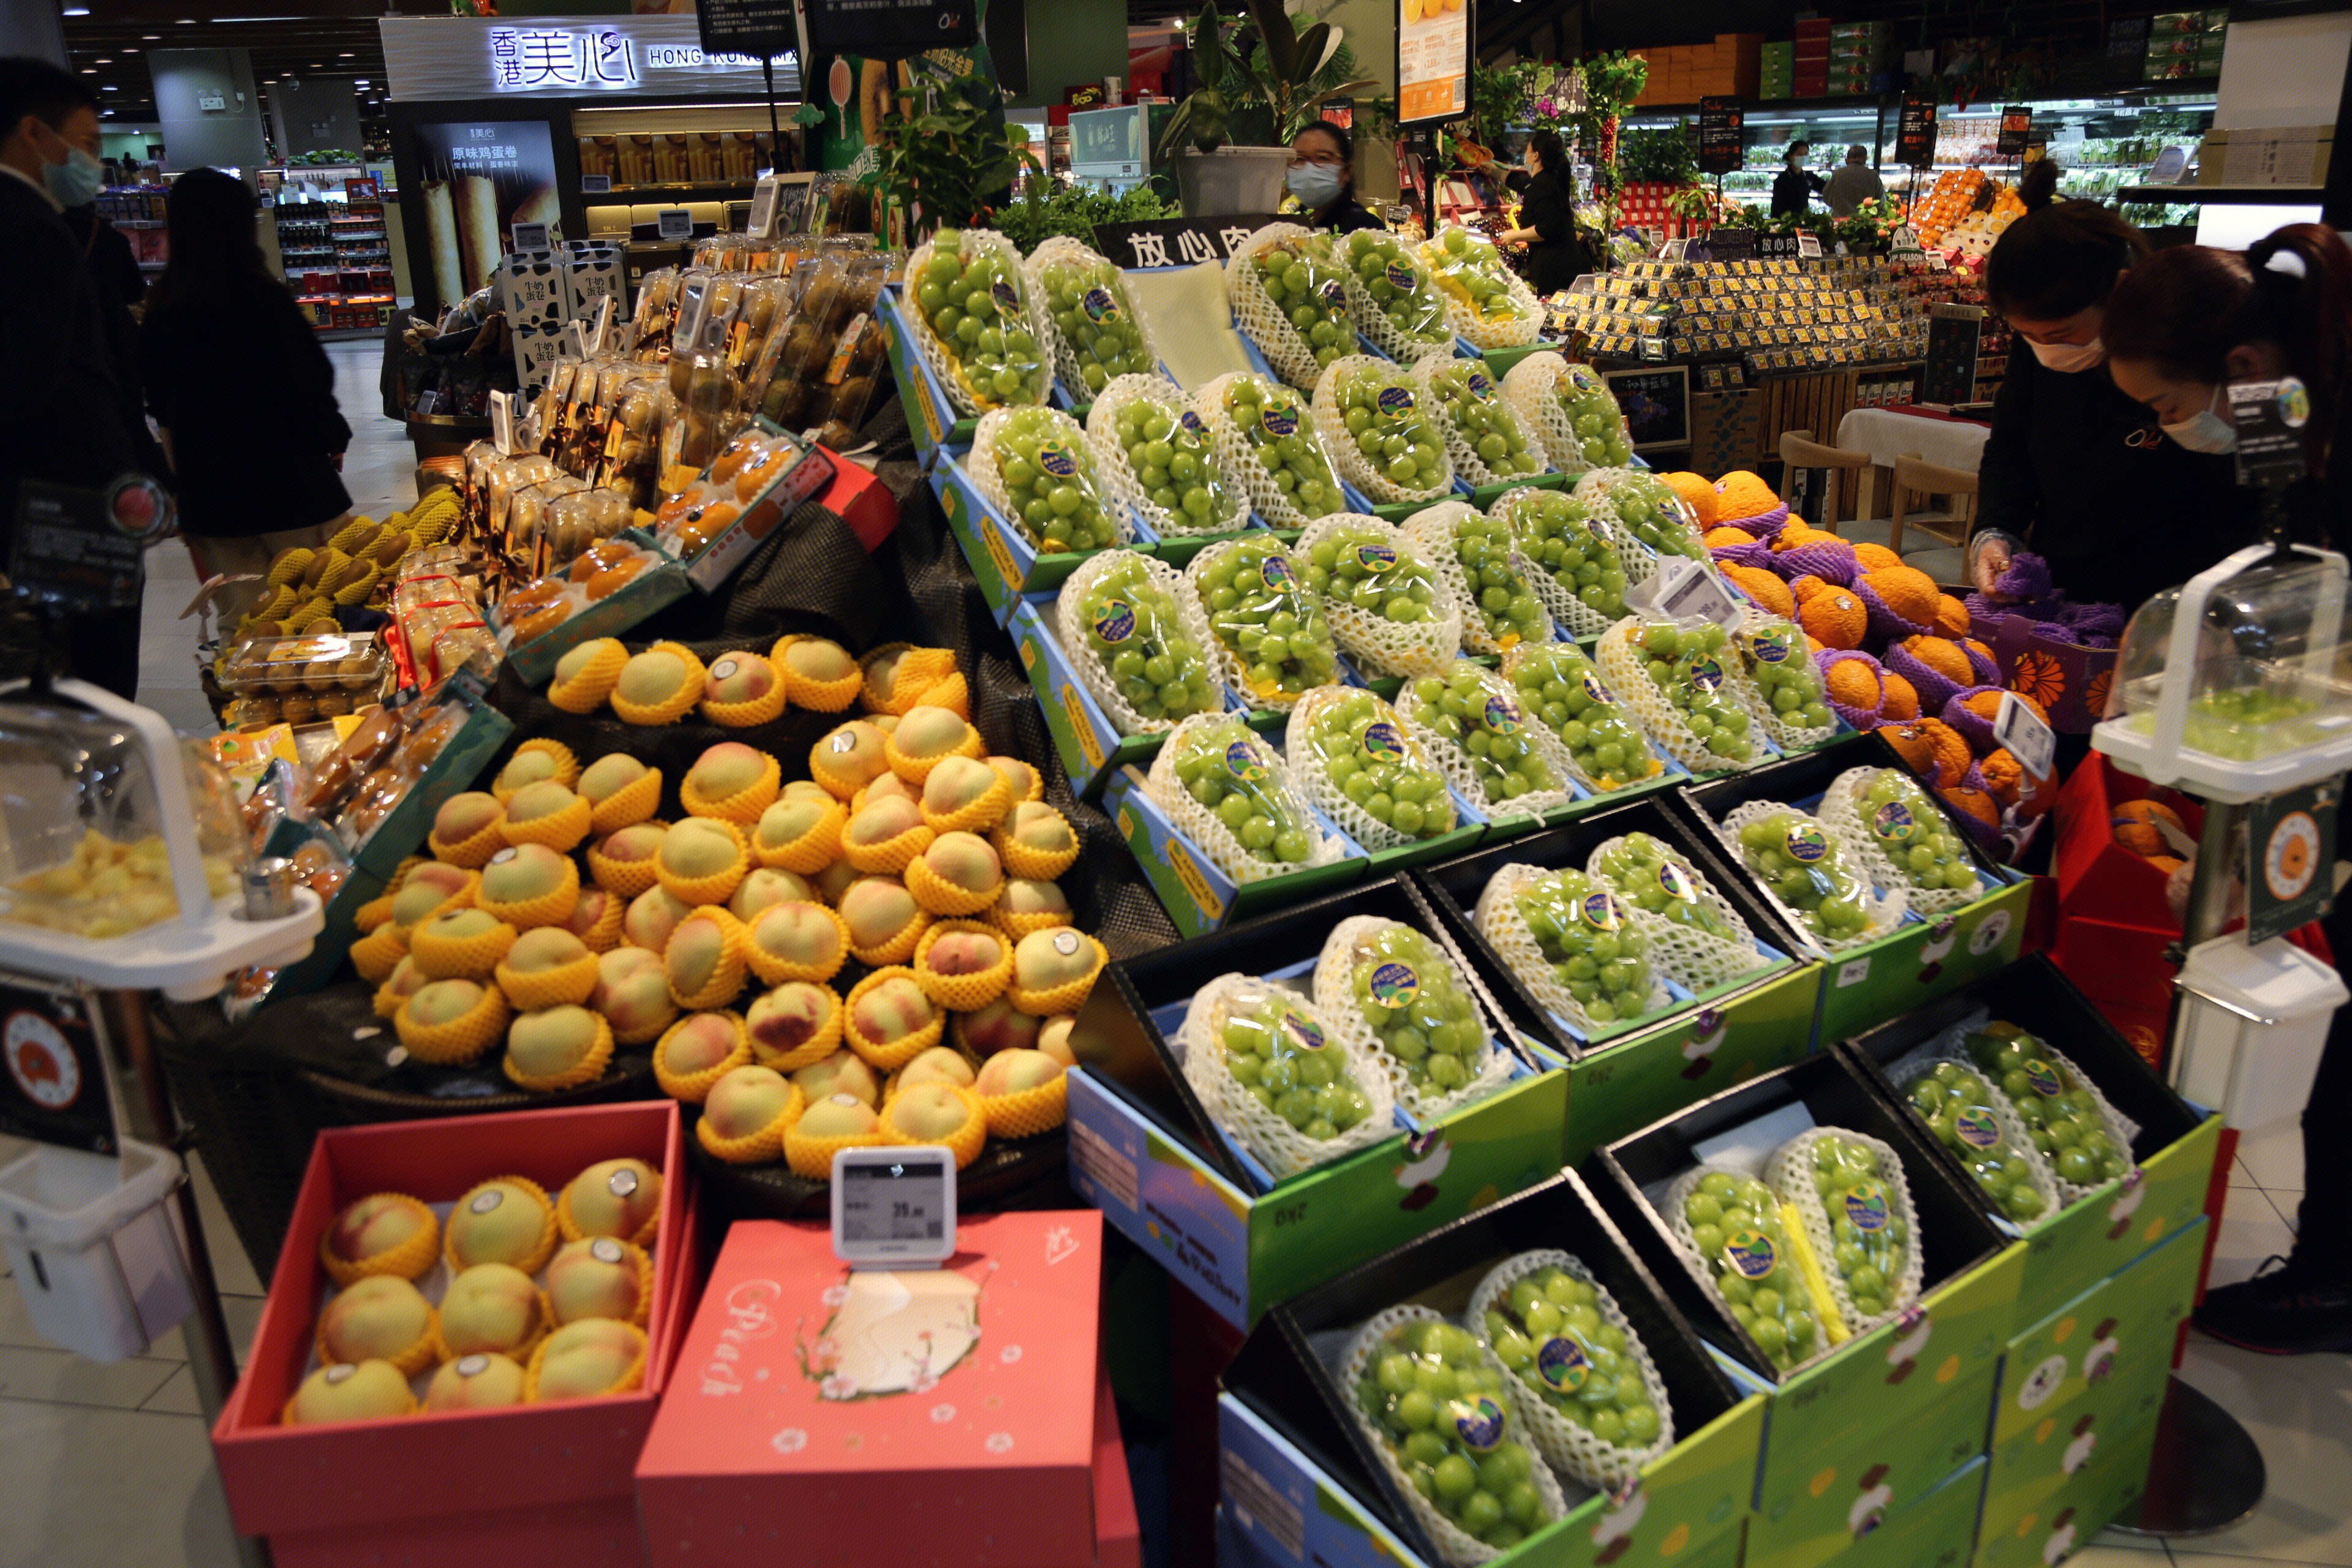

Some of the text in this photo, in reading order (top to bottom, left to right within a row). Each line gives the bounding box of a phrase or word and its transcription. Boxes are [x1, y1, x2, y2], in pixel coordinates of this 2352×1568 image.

[492, 30, 522, 86] 香港
[522, 31, 638, 84] 美心
[650, 49, 701, 64] HONG
[452, 146, 518, 160] 原味鸡蛋卷
[1762, 238, 1796, 252] 放心肉
[524, 281, 544, 290] 牛奶
[586, 277, 605, 287] 牛奶
[526, 291, 545, 301] 蛋卷
[587, 287, 606, 297] 蛋卷
[535, 342, 554, 352] 牛奶
[537, 352, 555, 362] 蛋卷
